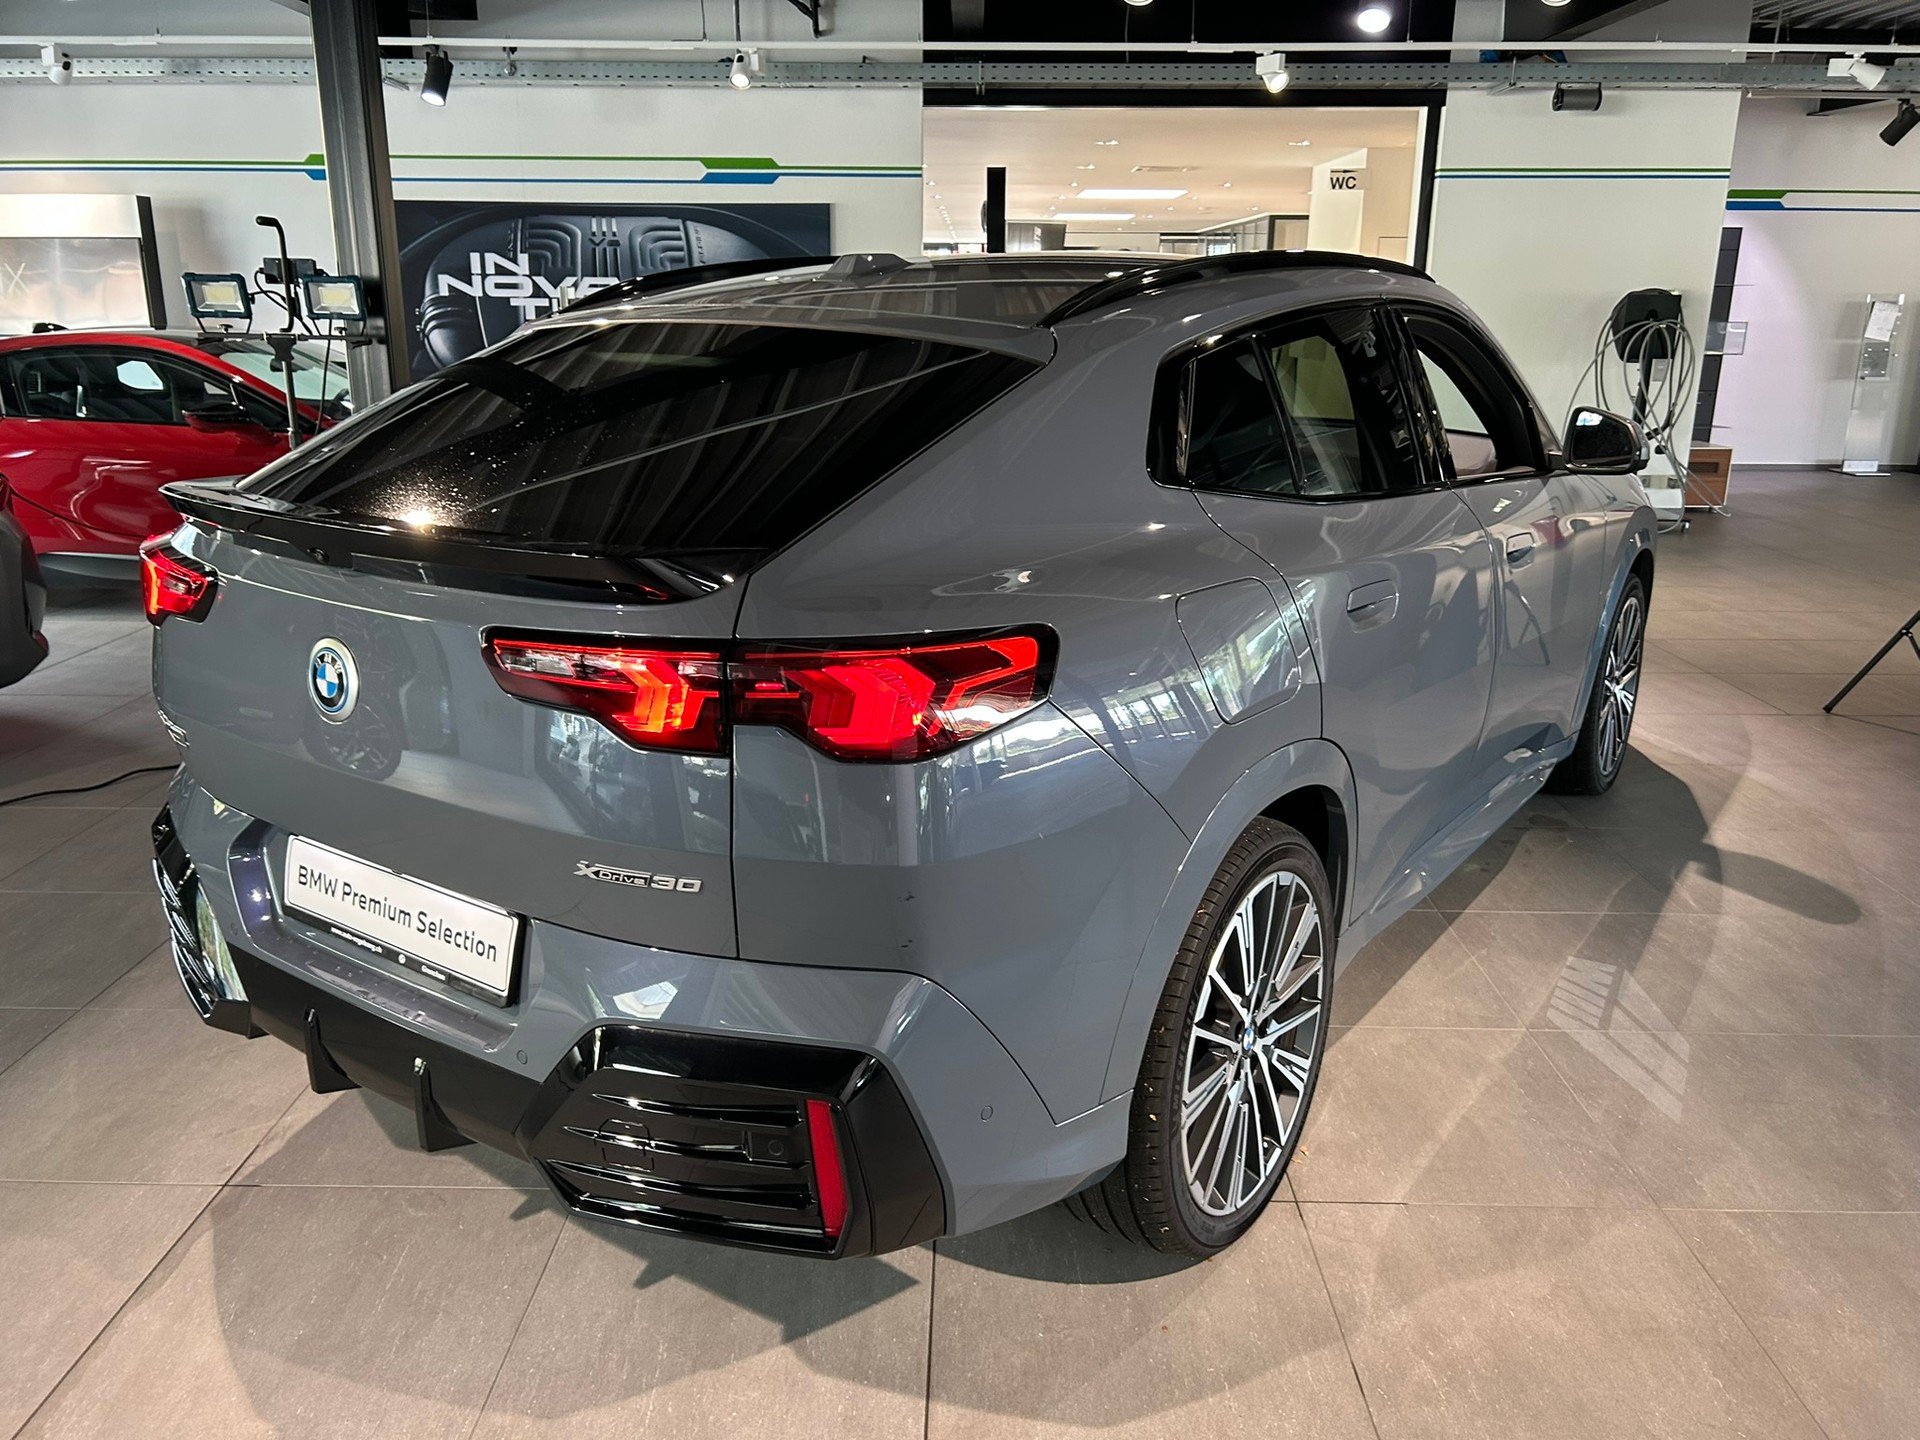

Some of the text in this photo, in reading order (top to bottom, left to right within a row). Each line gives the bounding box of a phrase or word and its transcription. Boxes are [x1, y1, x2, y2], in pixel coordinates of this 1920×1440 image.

[1330, 176, 1357, 189] WC
[469, 251, 530, 275] IN
[298, 865, 338, 897] BMW
[342, 882, 412, 928] Premium
[417, 911, 497, 962] Selection
